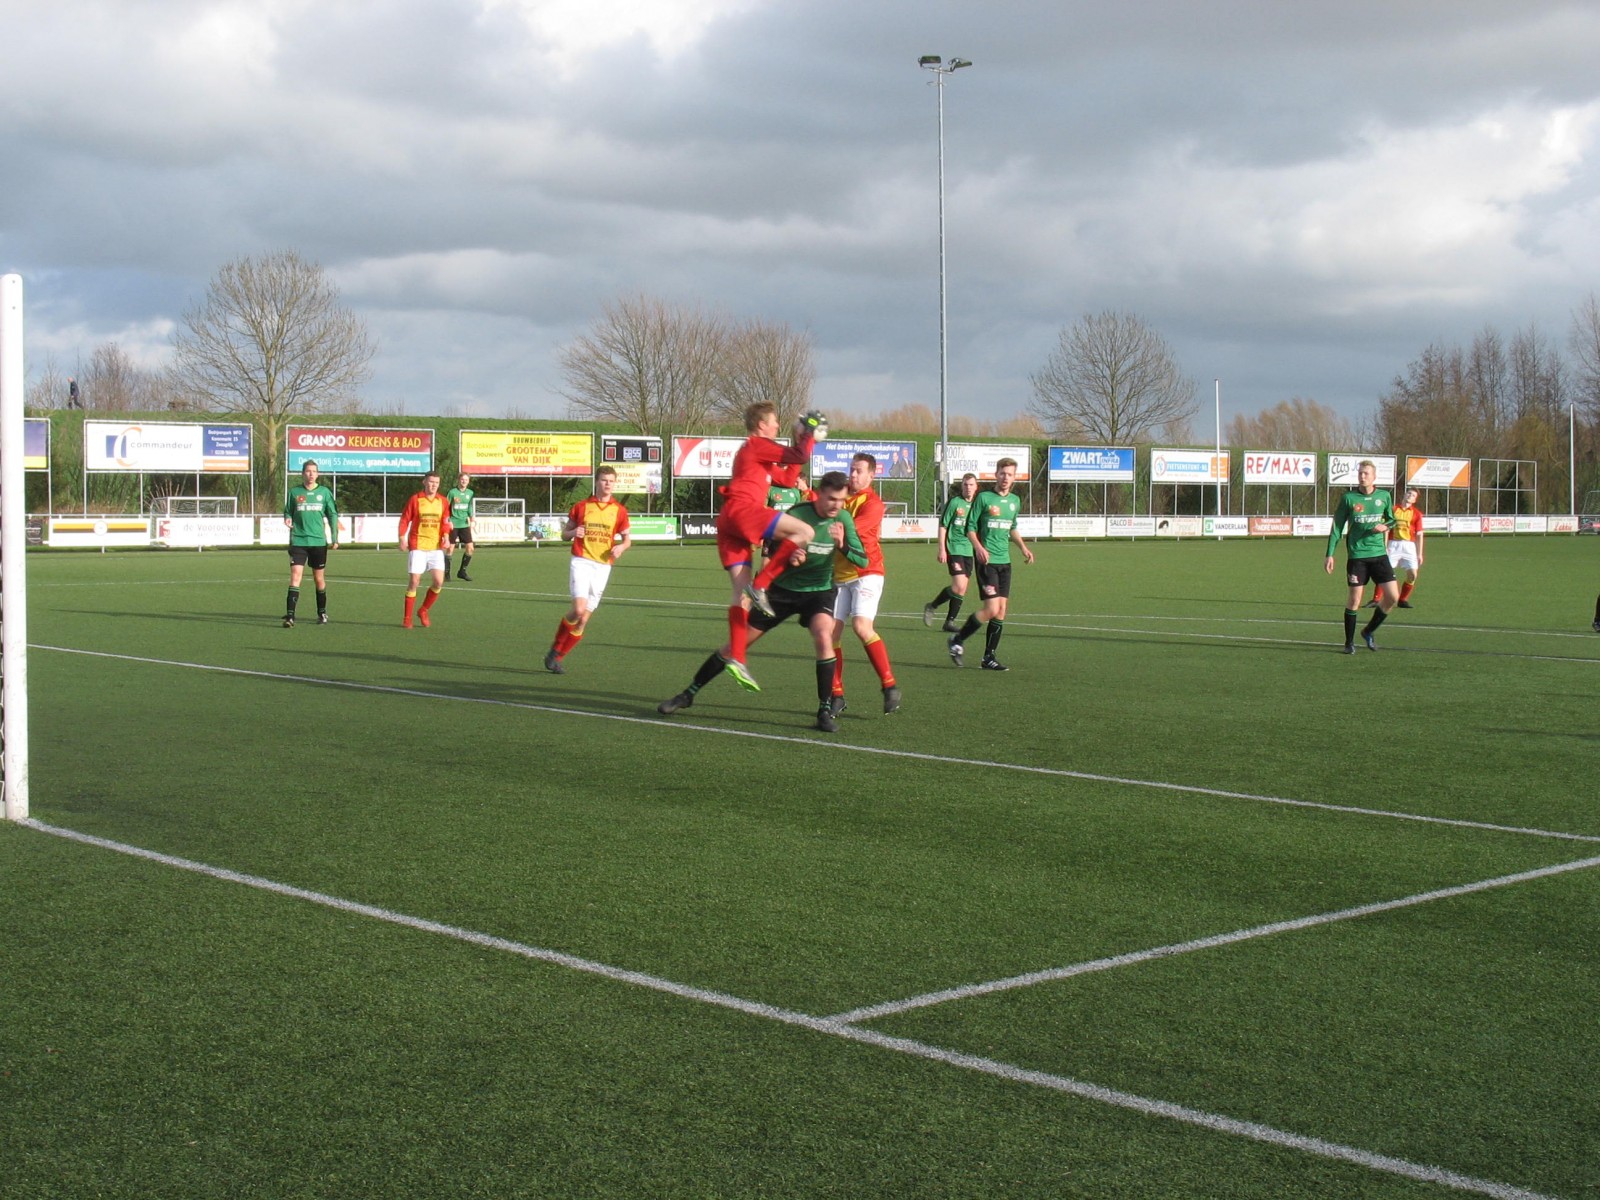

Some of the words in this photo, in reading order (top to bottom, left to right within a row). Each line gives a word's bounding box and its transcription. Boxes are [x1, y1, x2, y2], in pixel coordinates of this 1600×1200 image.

[130, 441, 193, 449] commandeur
[298, 434, 346, 447] GRANDO
[348, 435, 391, 448] KEUKENS
[393, 437, 400, 448] &
[402, 437, 422, 448] BAD
[506, 446, 558, 455] GROOTEMAN
[837, 443, 853, 451] beste
[854, 443, 900, 452] hypotheekadvies
[713, 450, 732, 458] NIEK
[1062, 451, 1102, 464] ZWART
[342, 458, 365, 467] Zwaag,
[366, 458, 421, 468] grando.nl/hoorn
[513, 456, 528, 464] VAN
[532, 456, 551, 465] DIJK
[1246, 456, 1300, 474] RE/MAX
[1331, 457, 1350, 474] Etos
[1109, 519, 1127, 527] SALCO
[183, 524, 194, 532] de
[684, 523, 700, 535] Van
[701, 523, 718, 535] Mos
